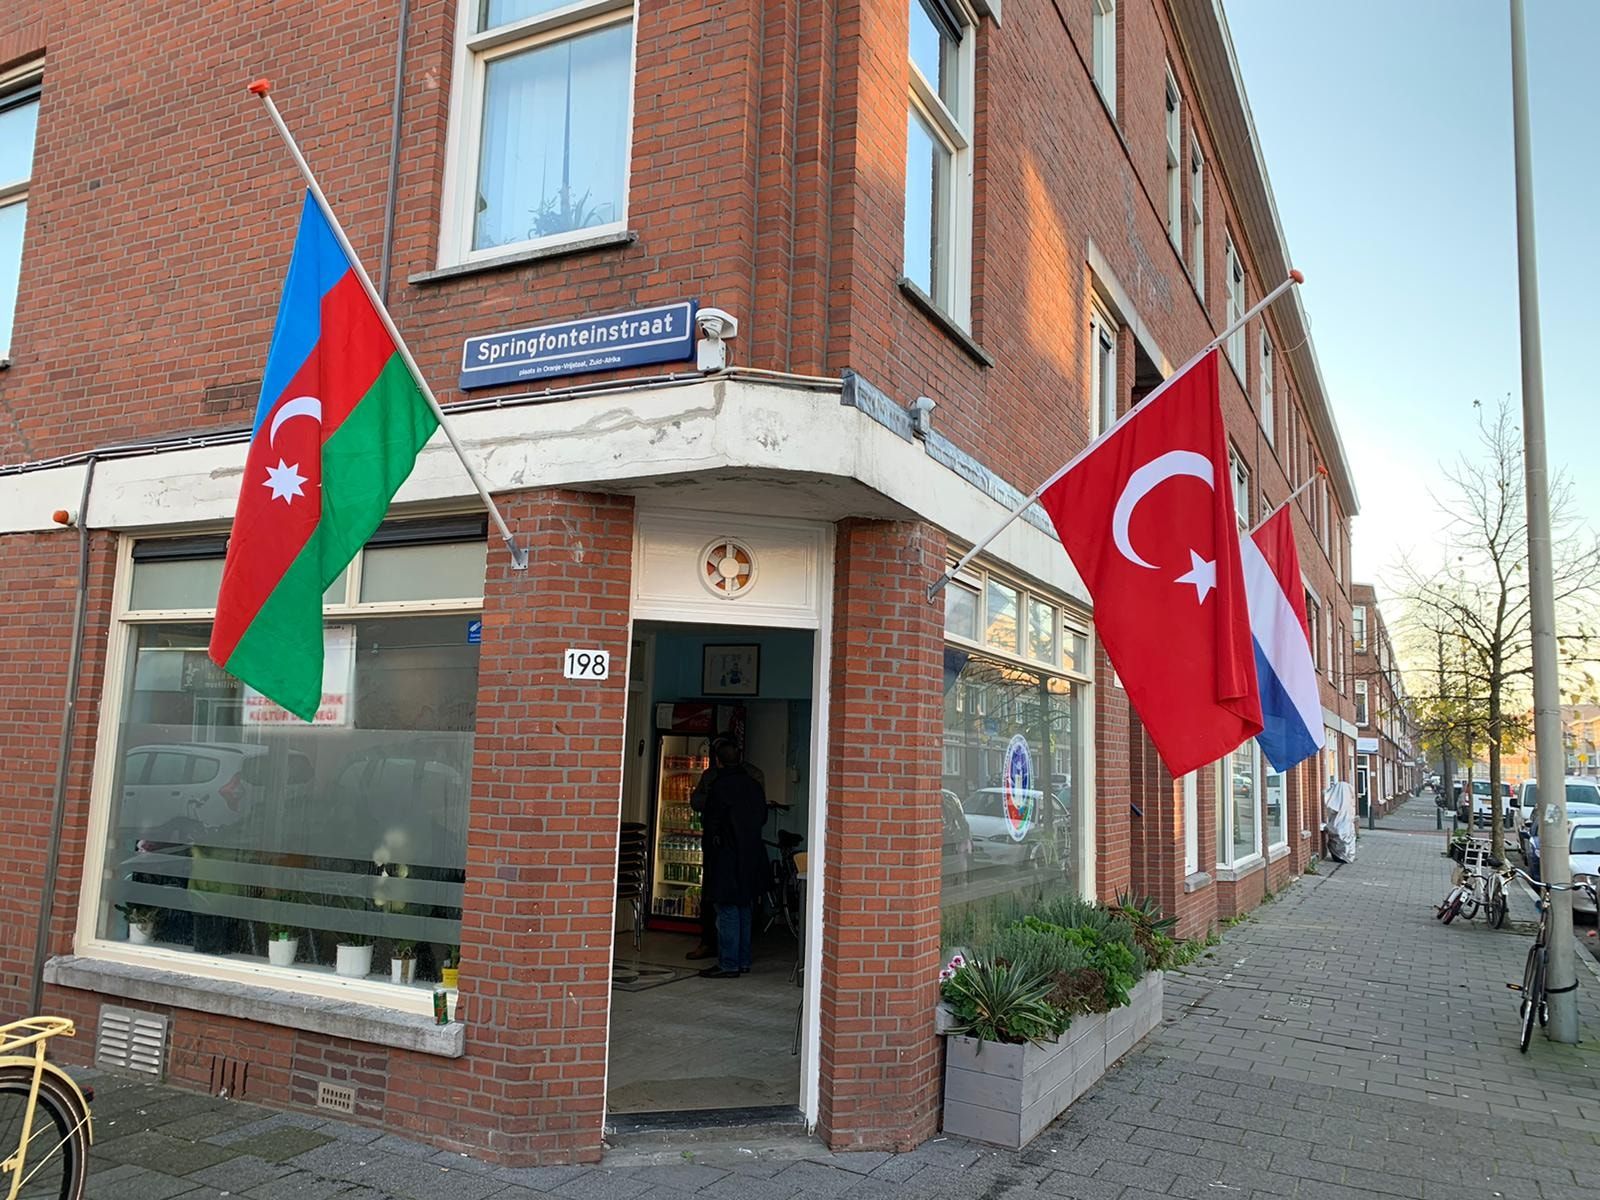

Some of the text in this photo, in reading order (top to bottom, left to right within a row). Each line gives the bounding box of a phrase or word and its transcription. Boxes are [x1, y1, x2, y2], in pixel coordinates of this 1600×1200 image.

[477, 312, 674, 363] Springfonteinstraat
[589, 356, 621, 366] Zuid-Afrika
[568, 653, 606, 676] 198
